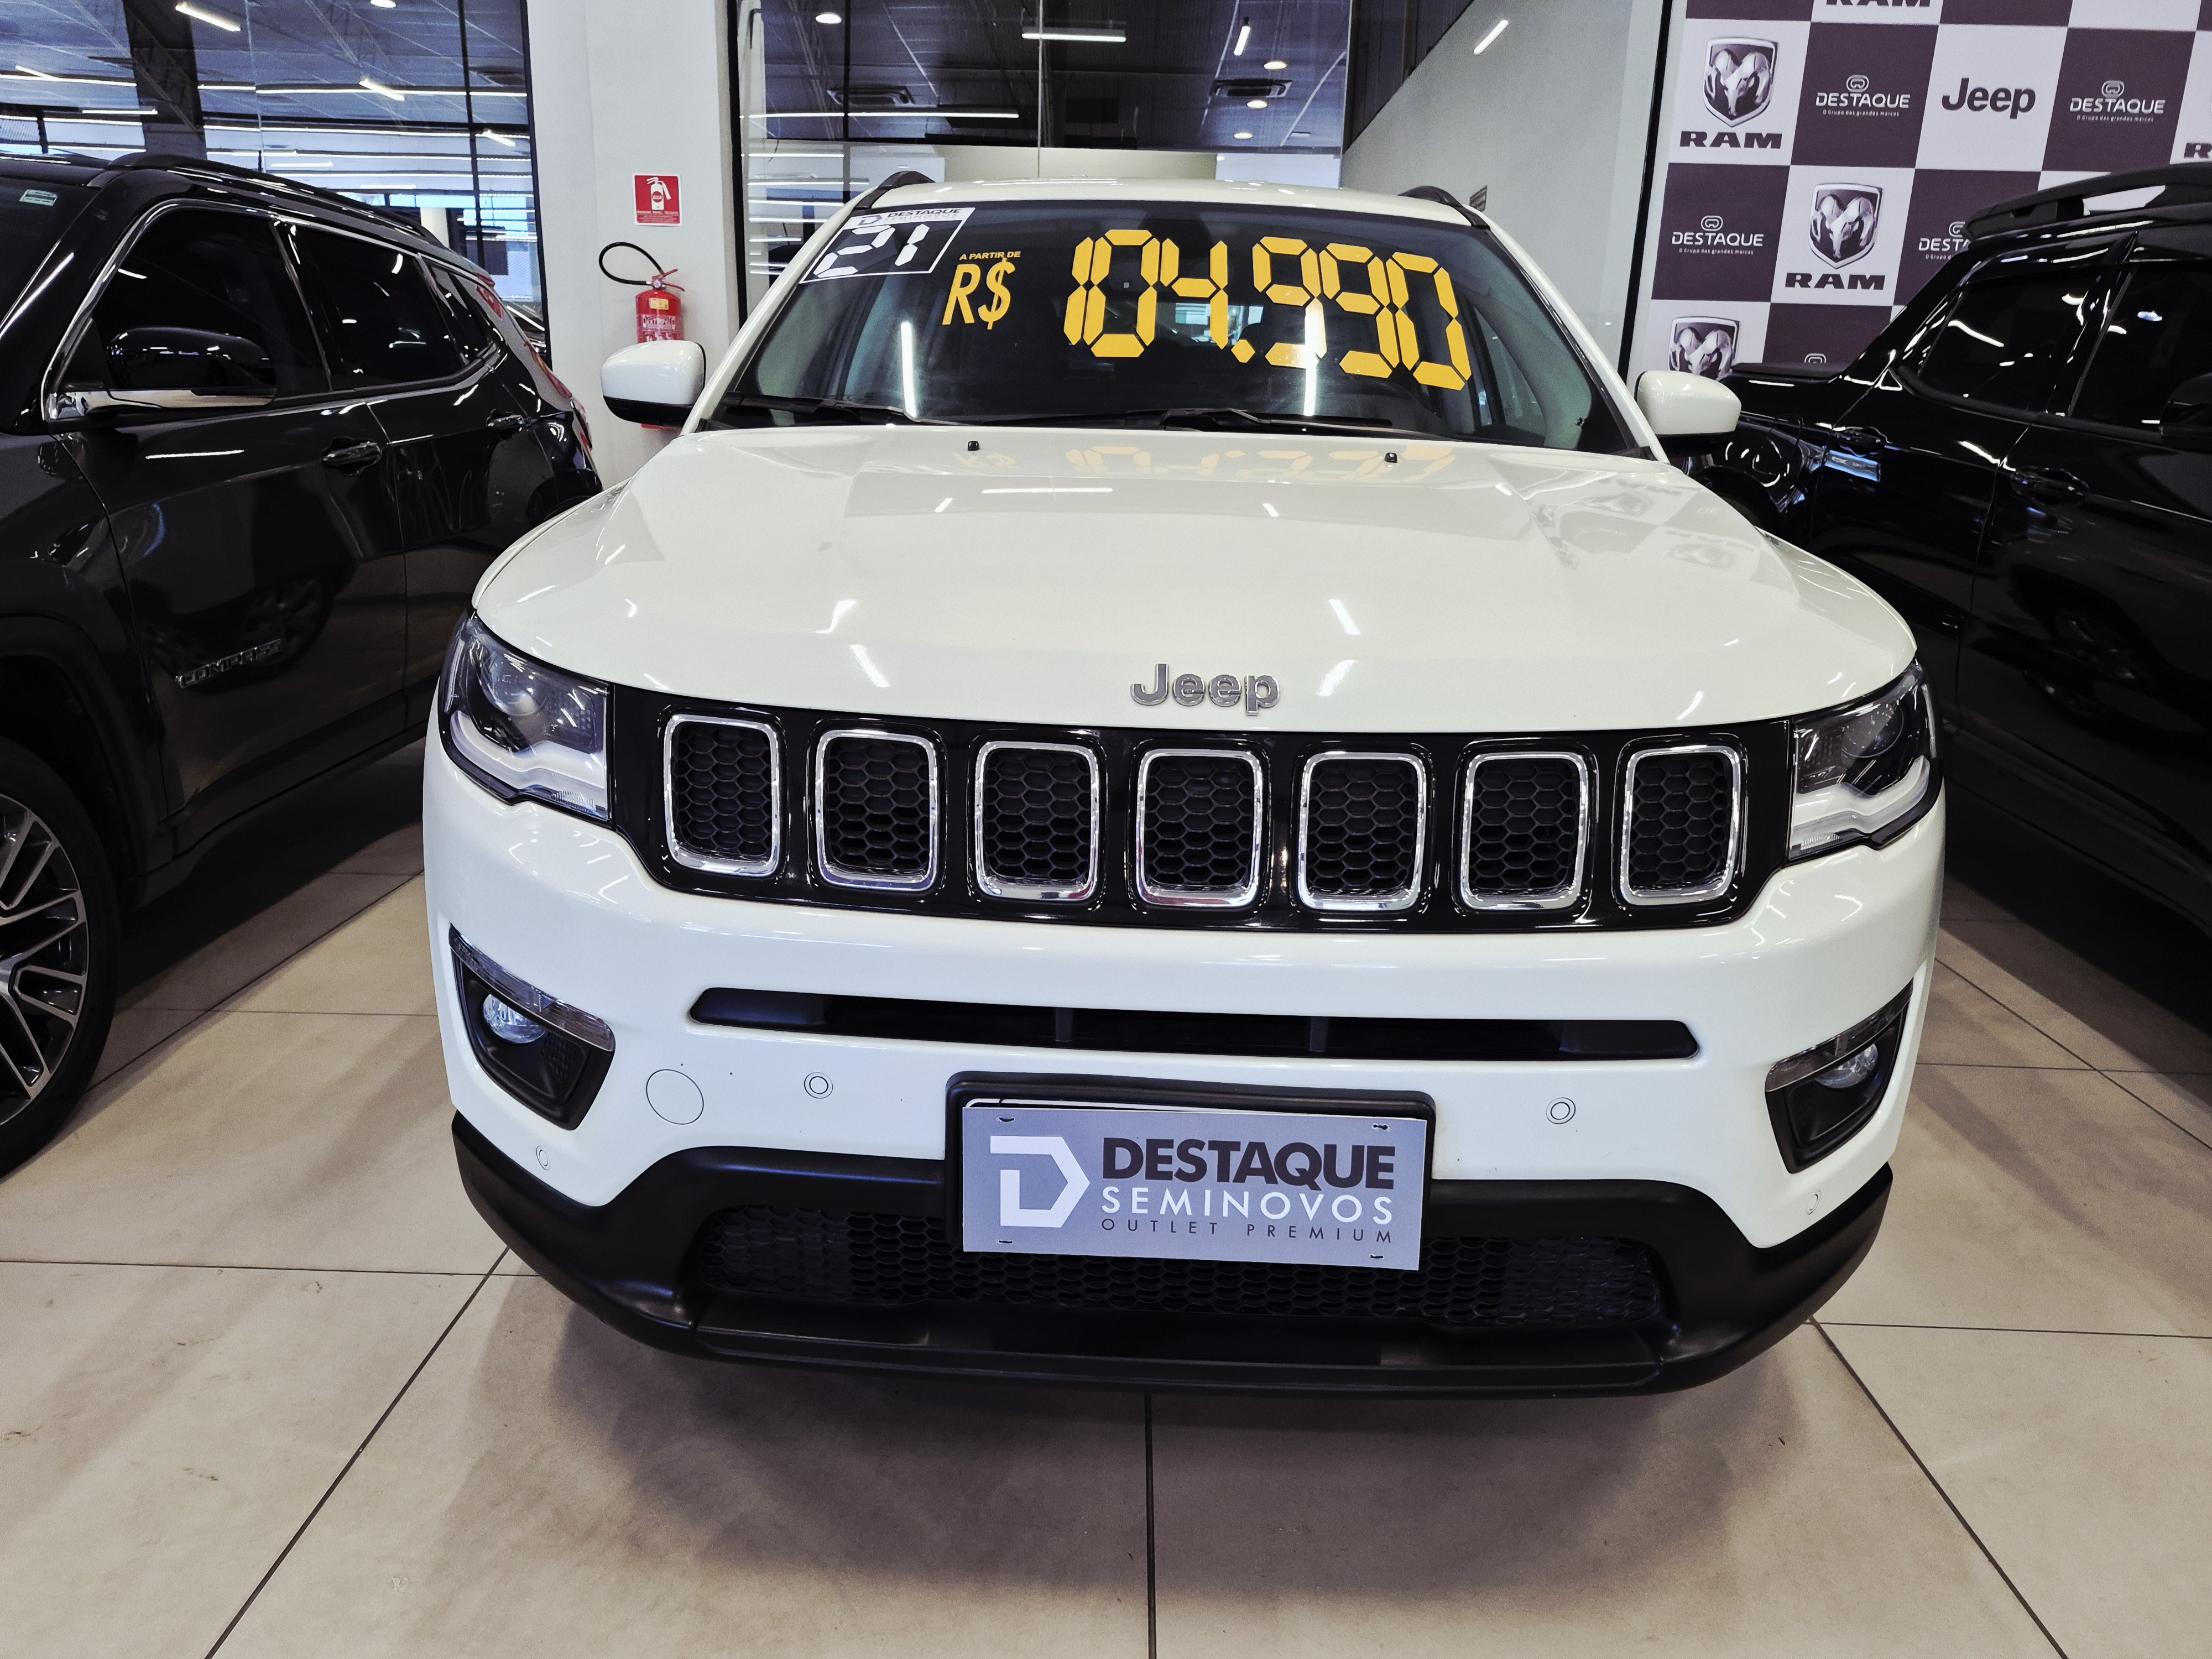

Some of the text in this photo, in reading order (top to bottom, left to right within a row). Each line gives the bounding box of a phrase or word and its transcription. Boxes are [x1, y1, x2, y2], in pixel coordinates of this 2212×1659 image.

[1815, 92, 1911, 108] DESTAQUE
[1942, 77, 2036, 119] Jeep
[2070, 98, 2166, 114] DESTAQUE
[1680, 131, 1782, 149] RAM
[888, 209, 961, 217] DESTAQUE
[813, 224, 930, 278] 21
[1672, 232, 1764, 246] DESTAQUE
[1785, 273, 1885, 290] RAM
[942, 229, 1471, 390] R$ 104.990
[1131, 663, 1281, 716] Jeep
[1103, 1137, 1395, 1191] DESTAQUE
[1101, 1186, 1392, 1225] SEMINOVOS
[1102, 1218, 1391, 1243] OUTLET PREMIUM
